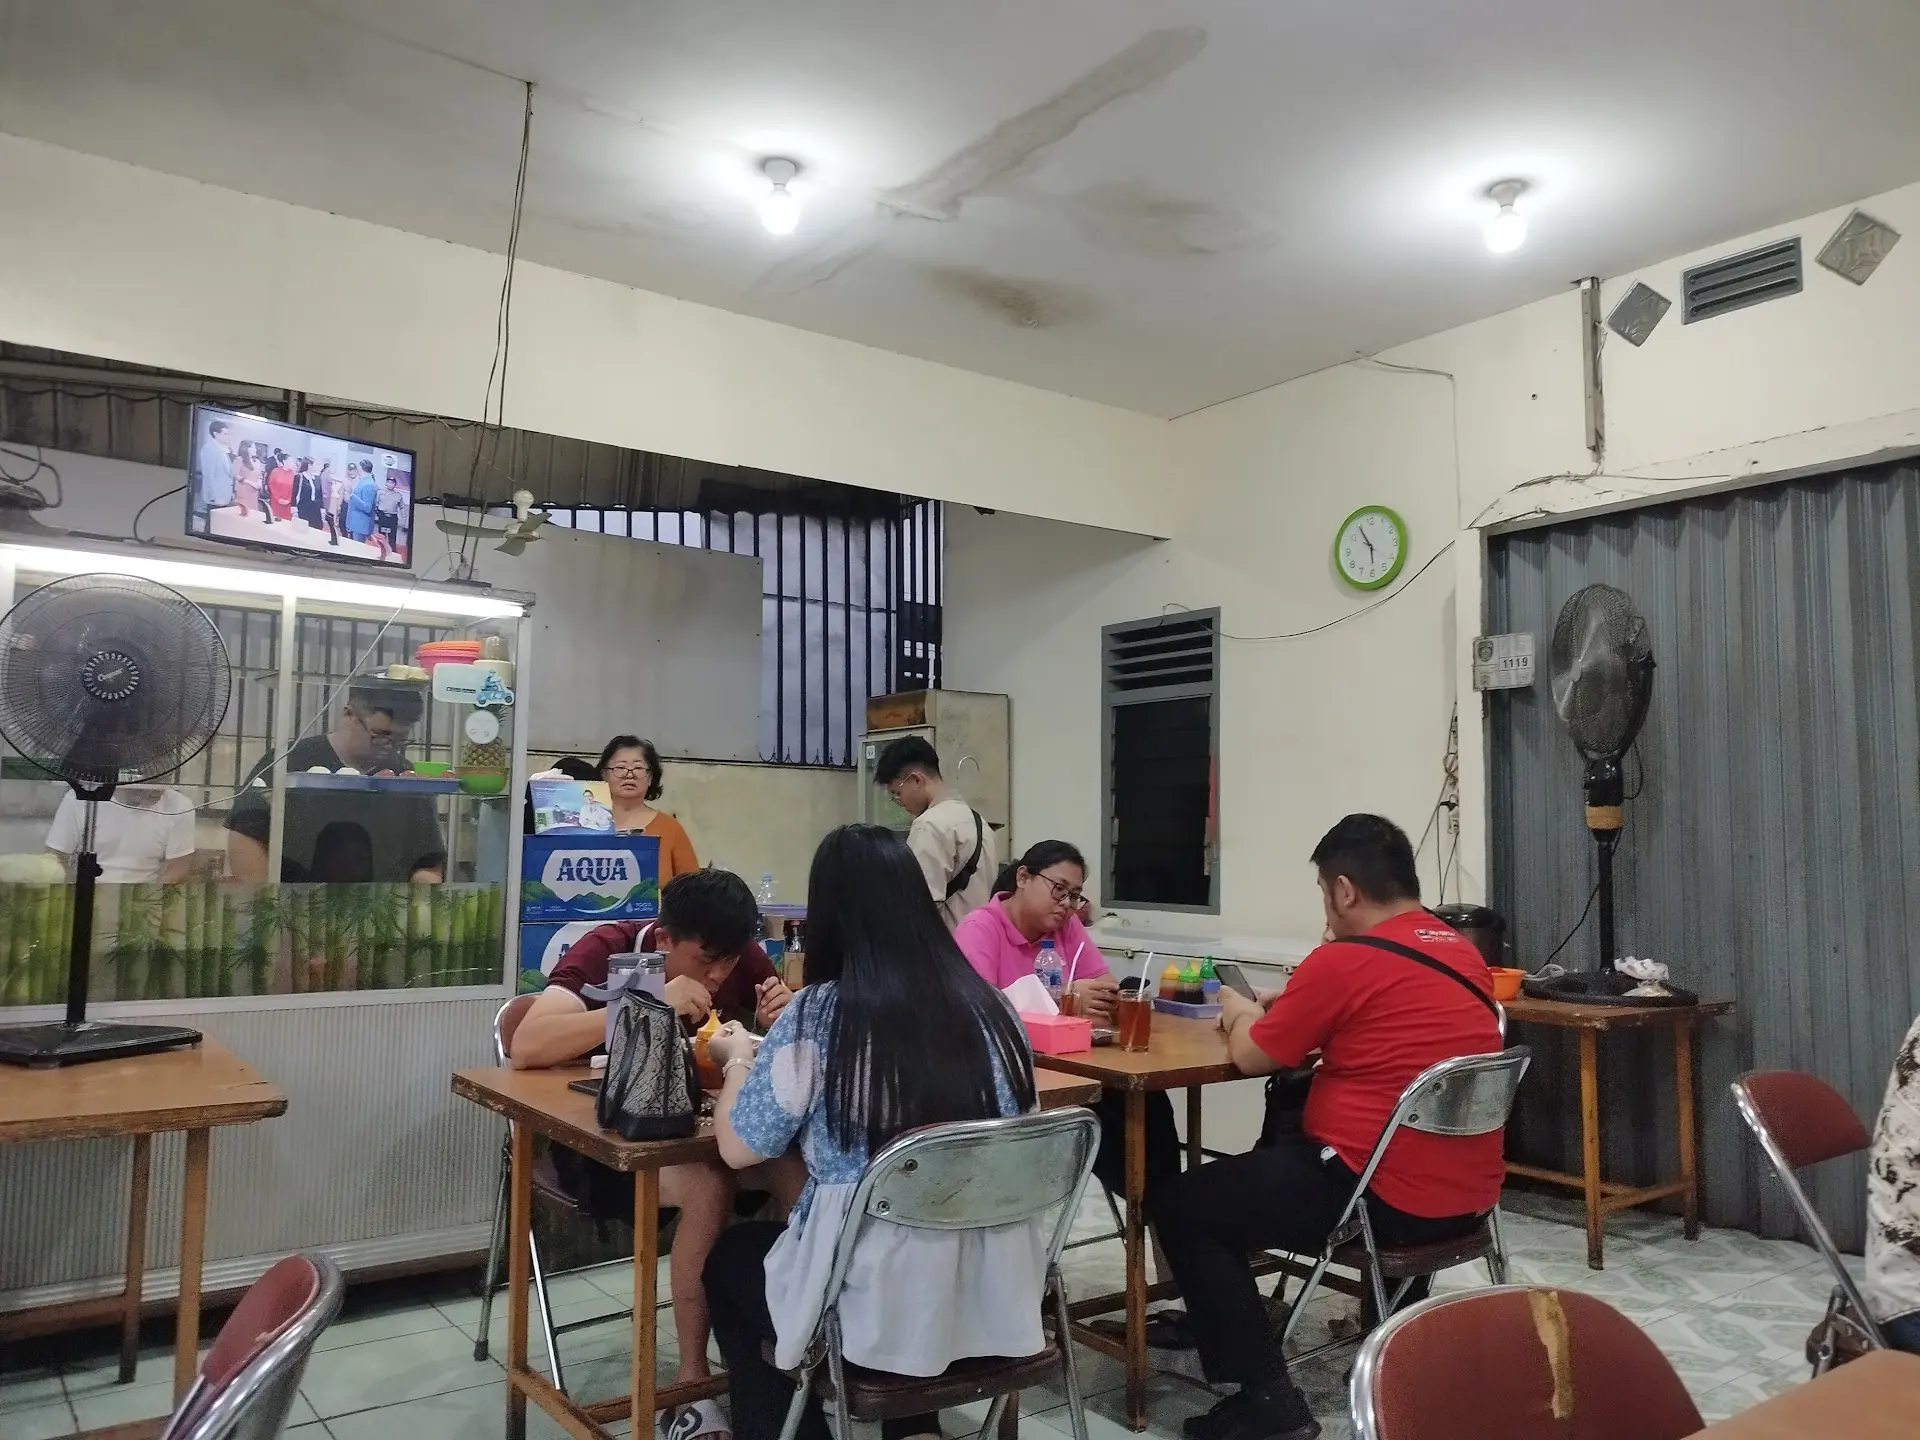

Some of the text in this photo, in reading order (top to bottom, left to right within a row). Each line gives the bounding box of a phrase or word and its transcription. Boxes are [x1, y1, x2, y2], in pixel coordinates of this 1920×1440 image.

[1381, 562, 1387, 571] 5
[1369, 569, 1376, 578] 6
[1503, 657, 1528, 668] 1119
[556, 857, 628, 886] AQUA
